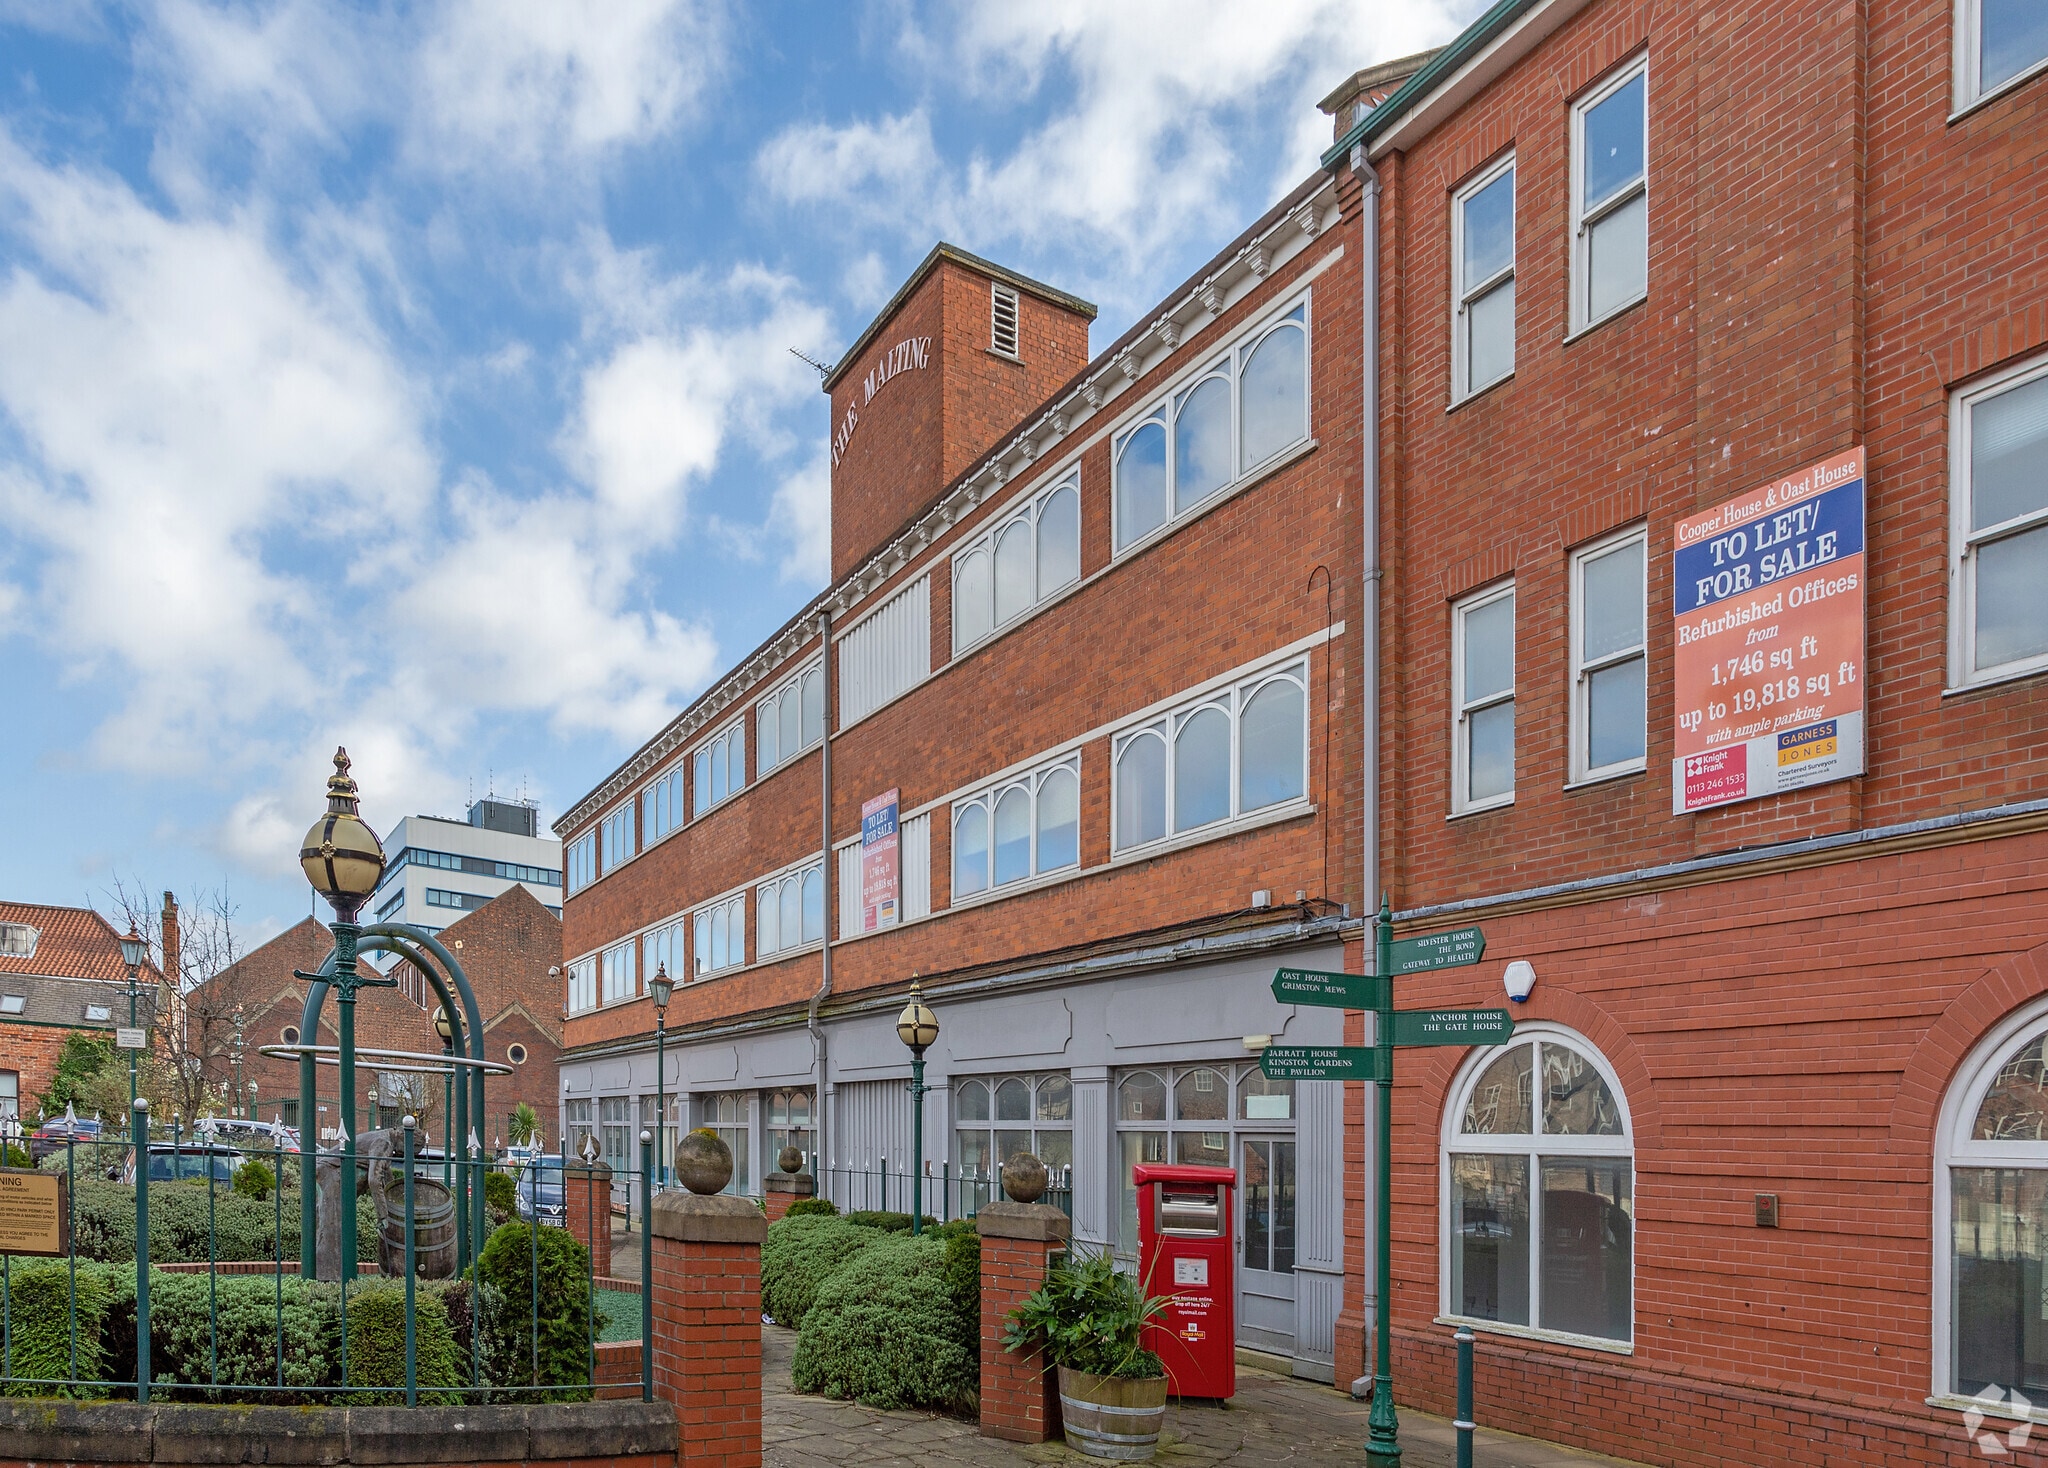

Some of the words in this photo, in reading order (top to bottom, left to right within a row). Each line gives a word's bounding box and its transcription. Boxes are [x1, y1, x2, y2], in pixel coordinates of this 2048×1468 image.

[831, 400, 858, 471] THE
[863, 336, 932, 407] MALTING
[1679, 516, 1721, 541] Cooper
[1724, 500, 1761, 525] House
[1765, 488, 1777, 508] &
[1780, 477, 1810, 501] Oast
[1813, 461, 1856, 488] House
[1710, 531, 1747, 567] TO
[1755, 500, 1821, 551] LET/
[1696, 563, 1752, 607] FOR
[1760, 531, 1837, 584] SALE
[1678, 593, 1783, 646] Refurbished
[1788, 574, 1858, 608] Offices
[1745, 625, 1779, 646] from
[1711, 650, 1764, 686] 1,746
[1770, 647, 1793, 670] sq
[1800, 635, 1818, 659] ft
[1679, 709, 1702, 732] up
[1708, 701, 1726, 721] to
[1733, 676, 1799, 715] 19,818
[1806, 672, 1831, 696] sq
[1837, 662, 1856, 686] ft
[1706, 729, 1731, 744] with
[1735, 717, 1771, 739] ample
[1772, 704, 1825, 732] parking
[1781, 724, 1833, 746] GARNESS
[1703, 751, 1728, 764] Knight
[1782, 742, 1833, 763] JONES
[1703, 761, 1724, 773] Frank
[1778, 765, 1807, 777] Chartered
[1808, 759, 1837, 770] Surveyors
[1687, 783, 1705, 794] 0113
[1707, 778, 1723, 790] 246
[1725, 773, 1745, 785] 1533
[1687, 788, 1745, 806] KnightFrank.co.uk
[866, 829, 876, 845] FOR
[877, 821, 893, 839] SALE
[1417, 936, 1449, 948] SILVESTER
[1453, 931, 1475, 942] HOUSE
[1438, 945, 1451, 954] THE
[1455, 942, 1475, 952] BOND
[1402, 958, 1431, 970] GATEWAY
[1435, 957, 1444, 965] TO
[1447, 952, 1474, 963] HEALTH
[1281, 972, 1300, 980] OAST
[1305, 974, 1329, 983] HOUSE
[1281, 982, 1320, 991] GRIMSTON
[1324, 986, 1346, 995] MEWS
[1429, 1013, 1467, 1022] ANCHOR
[1473, 1012, 1503, 1020] HOUSE
[1445, 1023, 1468, 1031] GATE
[1473, 1022, 1503, 1030] HOUSE
[1311, 1050, 1338, 1058] HOUSE
[1290, 1068, 1326, 1076] PAVILION
